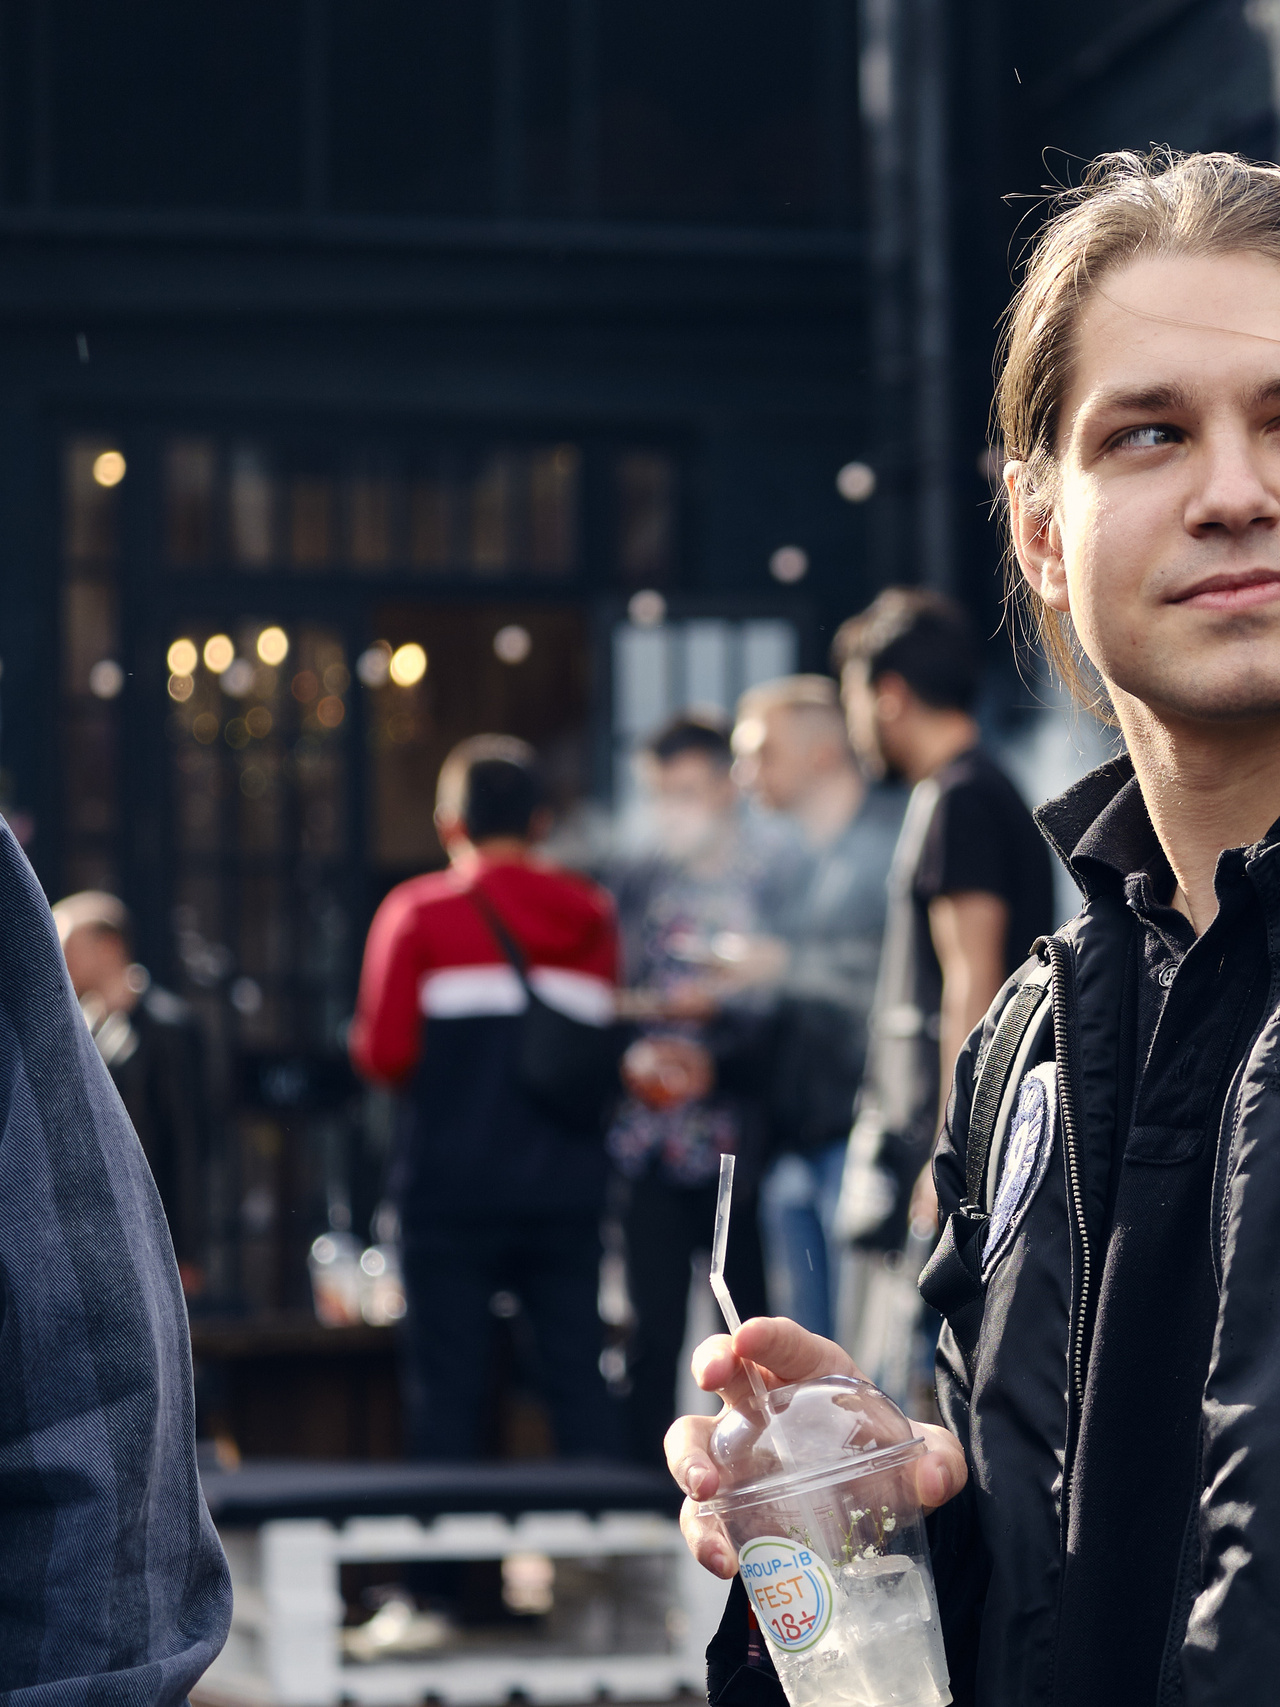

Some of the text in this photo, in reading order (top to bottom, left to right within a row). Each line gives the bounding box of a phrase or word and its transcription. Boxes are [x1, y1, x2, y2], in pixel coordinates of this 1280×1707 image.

[740, 1551, 812, 1578] GROUP-IB
[754, 1576, 803, 1610] FEST
[772, 1611, 816, 1644] 18+
